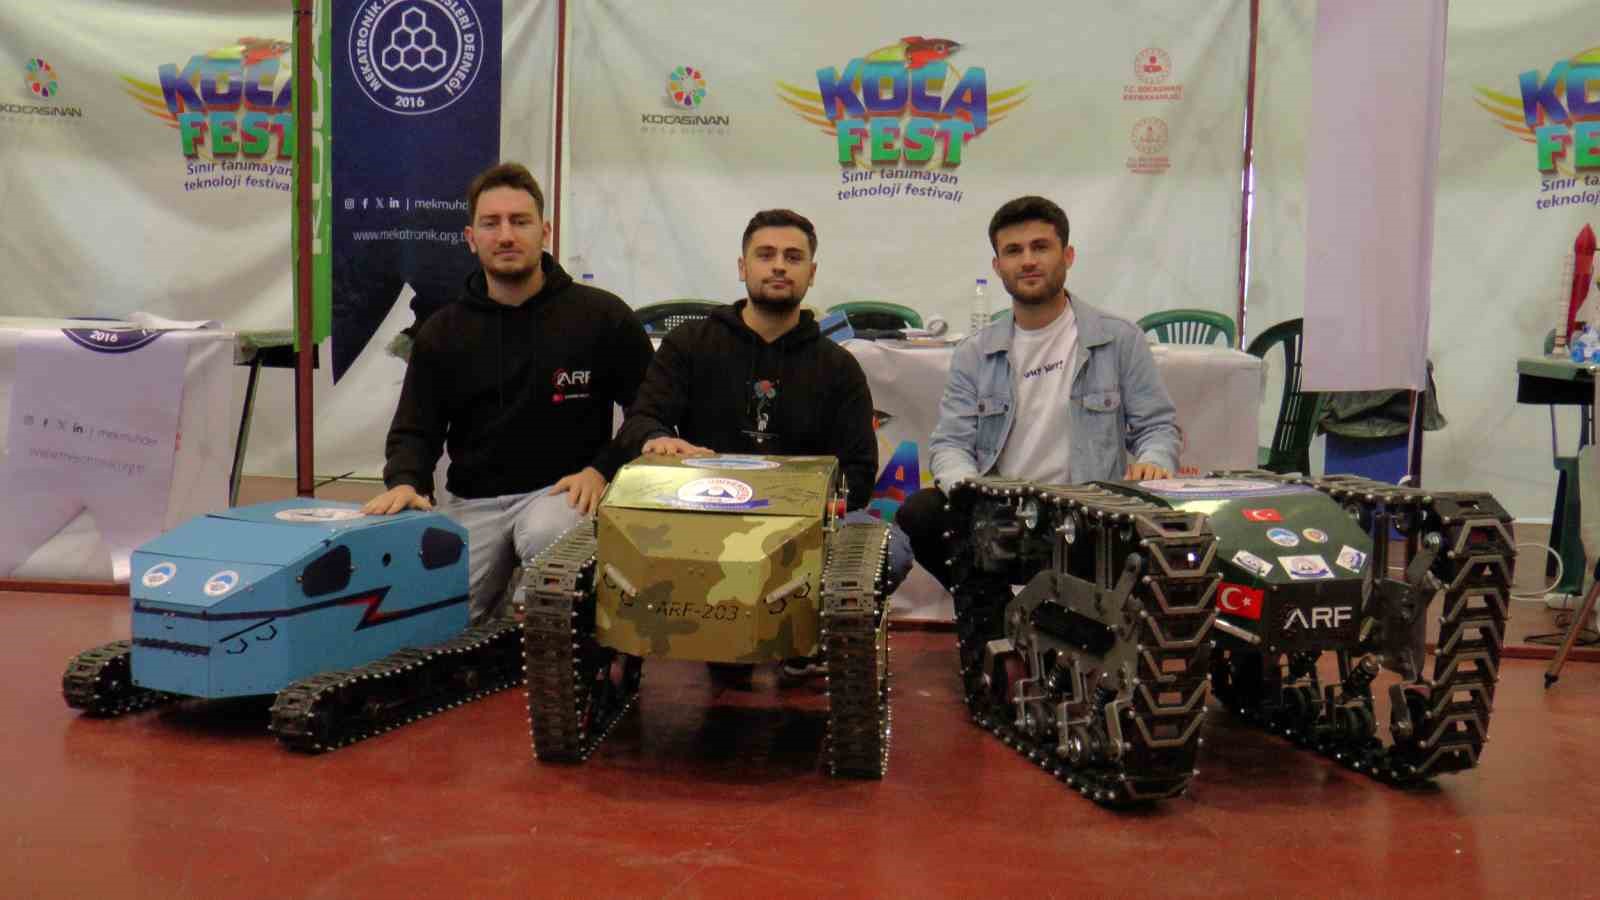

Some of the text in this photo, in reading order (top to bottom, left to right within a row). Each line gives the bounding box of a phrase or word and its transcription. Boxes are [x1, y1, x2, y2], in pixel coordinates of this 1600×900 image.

[395, 95, 425, 108] 2016
[816, 57, 988, 129] KOCA
[836, 117, 976, 168] FEST
[184, 174, 241, 193] teknoloji
[880, 167, 958, 185] tanımayan
[838, 182, 963, 203] teknoloji festivali
[89, 330, 119, 343] 2016
[556, 370, 592, 386] ARF
[656, 600, 739, 621] ARF-203
[1283, 606, 1353, 629] ARF
